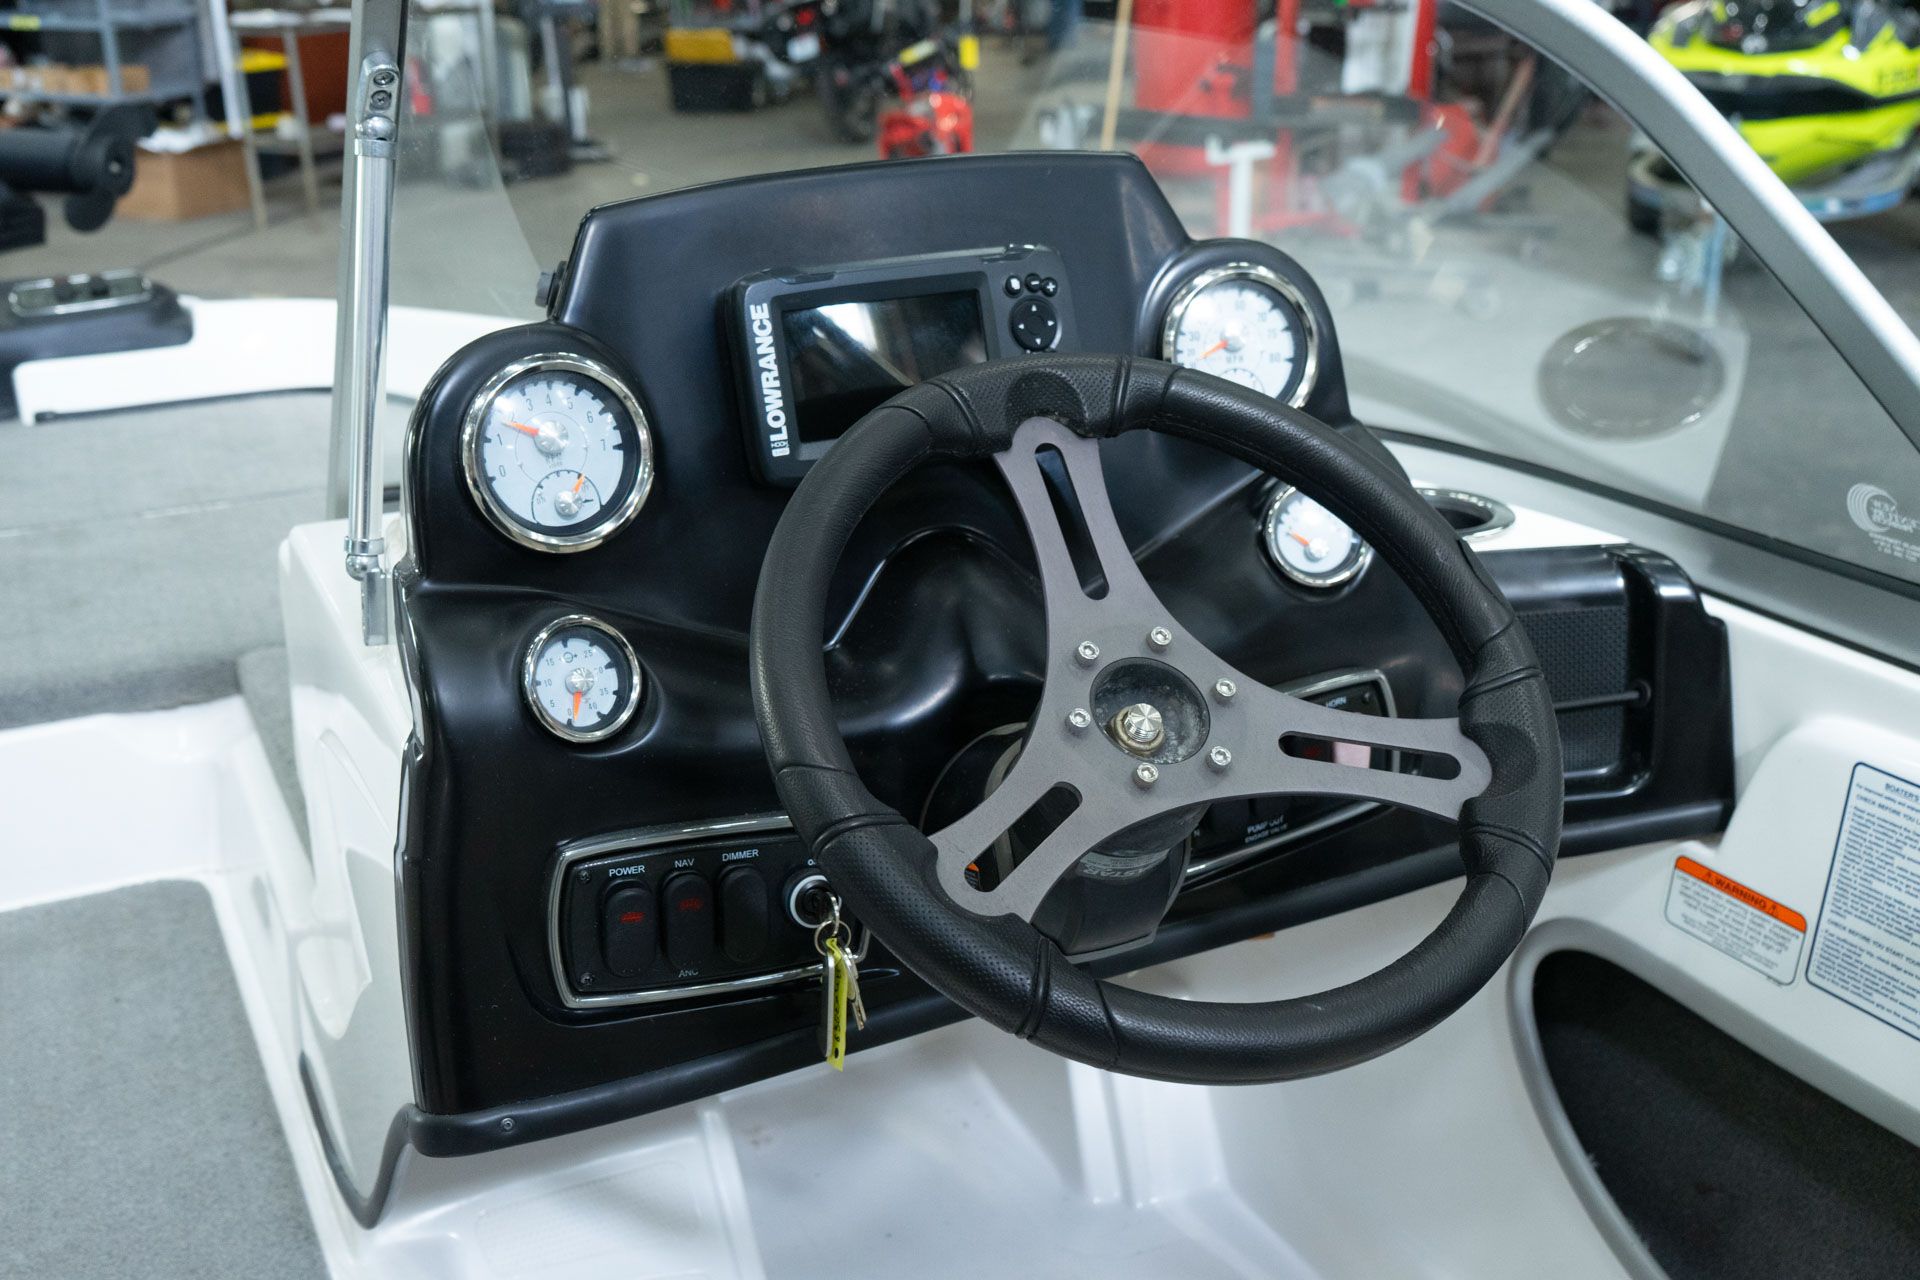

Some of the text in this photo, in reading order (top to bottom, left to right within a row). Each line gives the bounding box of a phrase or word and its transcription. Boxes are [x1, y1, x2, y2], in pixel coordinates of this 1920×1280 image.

[750, 302, 788, 441] LOWRANCE
[526, 398, 533, 411] 3
[546, 393, 552, 406] 4
[567, 397, 574, 410] 5
[586, 411, 594, 424] 6
[600, 438, 607, 451] 7
[498, 465, 506, 477] 0
[722, 849, 759, 862] DIMMER
[675, 858, 695, 869] NAV
[609, 865, 646, 877] POWER
[1715, 877, 1767, 910] WARNING
